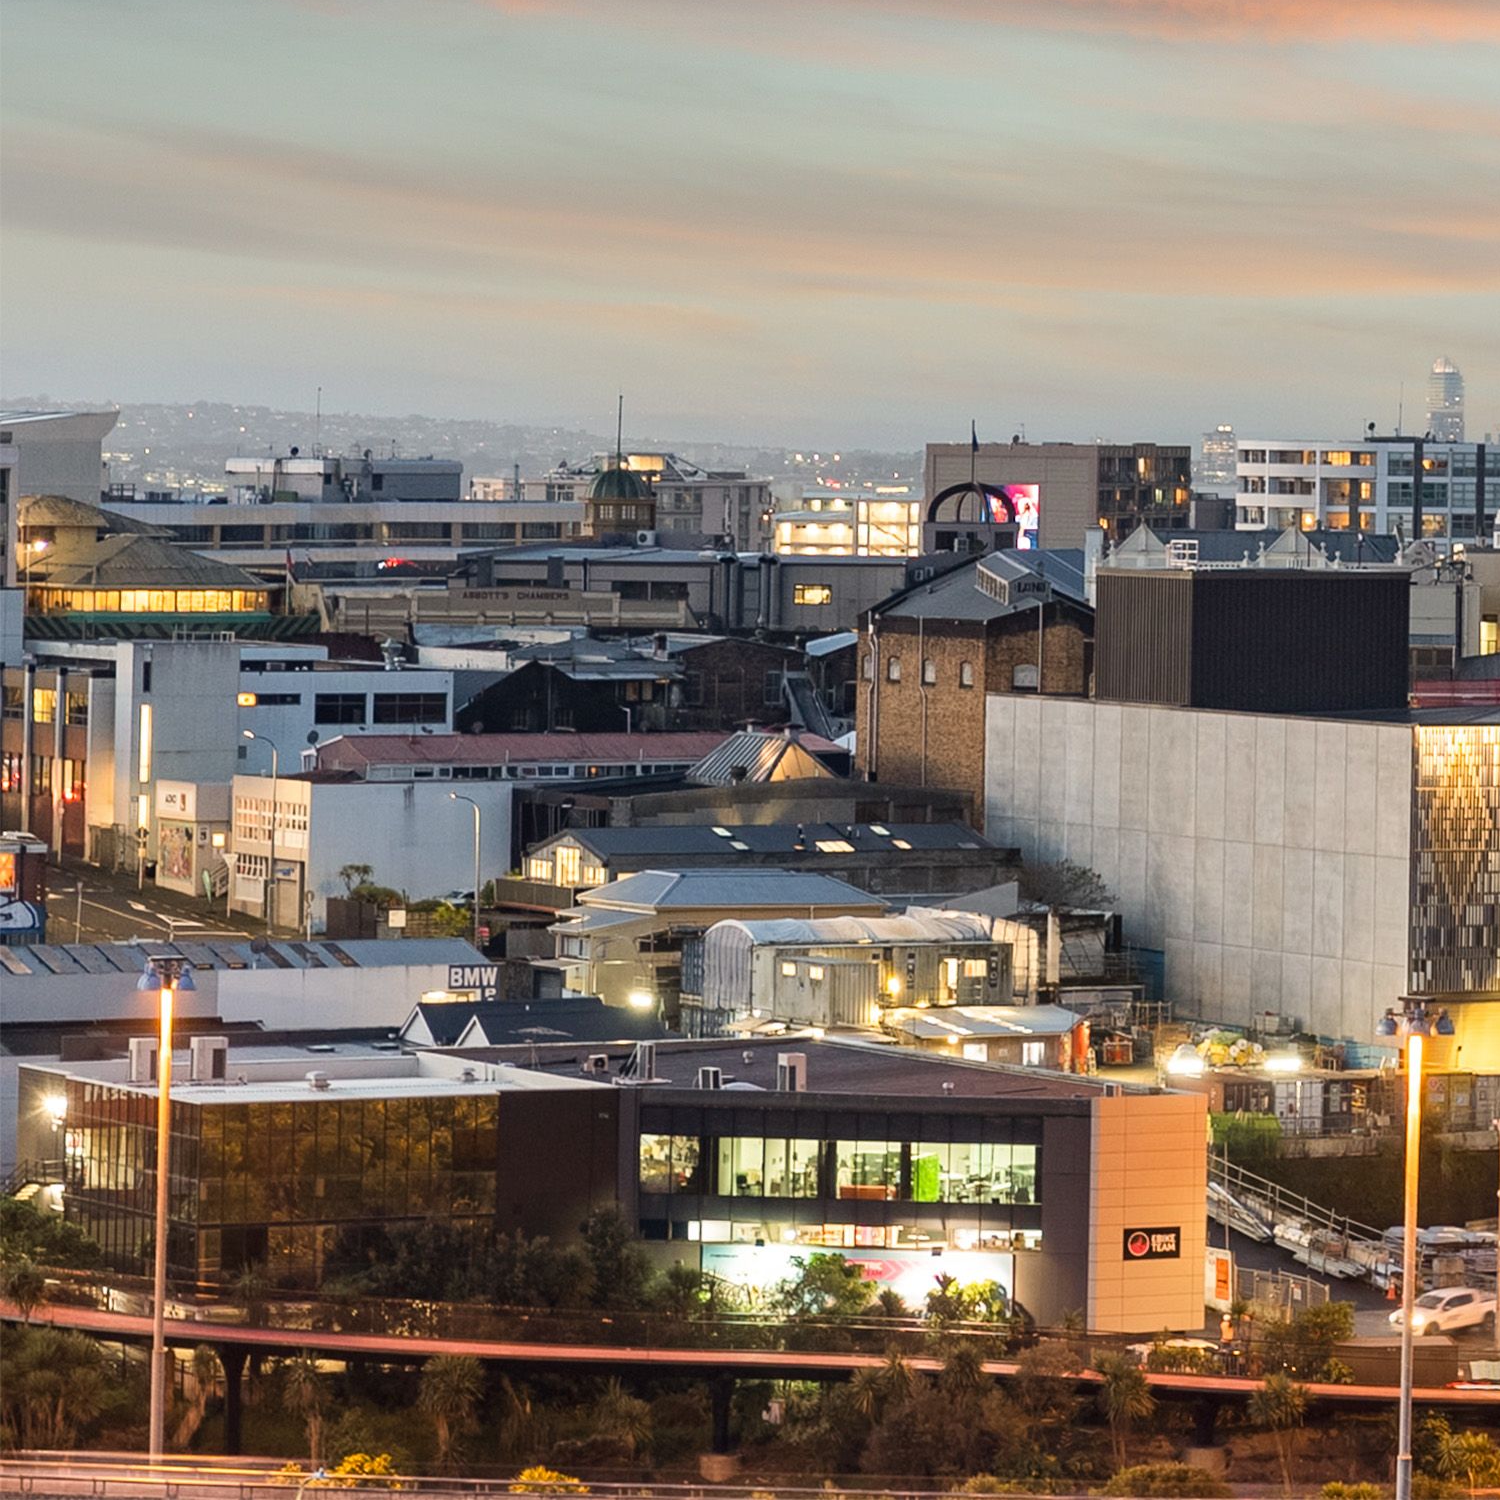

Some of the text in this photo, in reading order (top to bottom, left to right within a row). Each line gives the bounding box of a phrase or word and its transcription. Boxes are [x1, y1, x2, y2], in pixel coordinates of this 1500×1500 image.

[462, 591, 569, 601] ABBOTT'S CHAMBERS
[450, 967, 498, 986] BMW
[1151, 1242, 1176, 1252] TEAM
